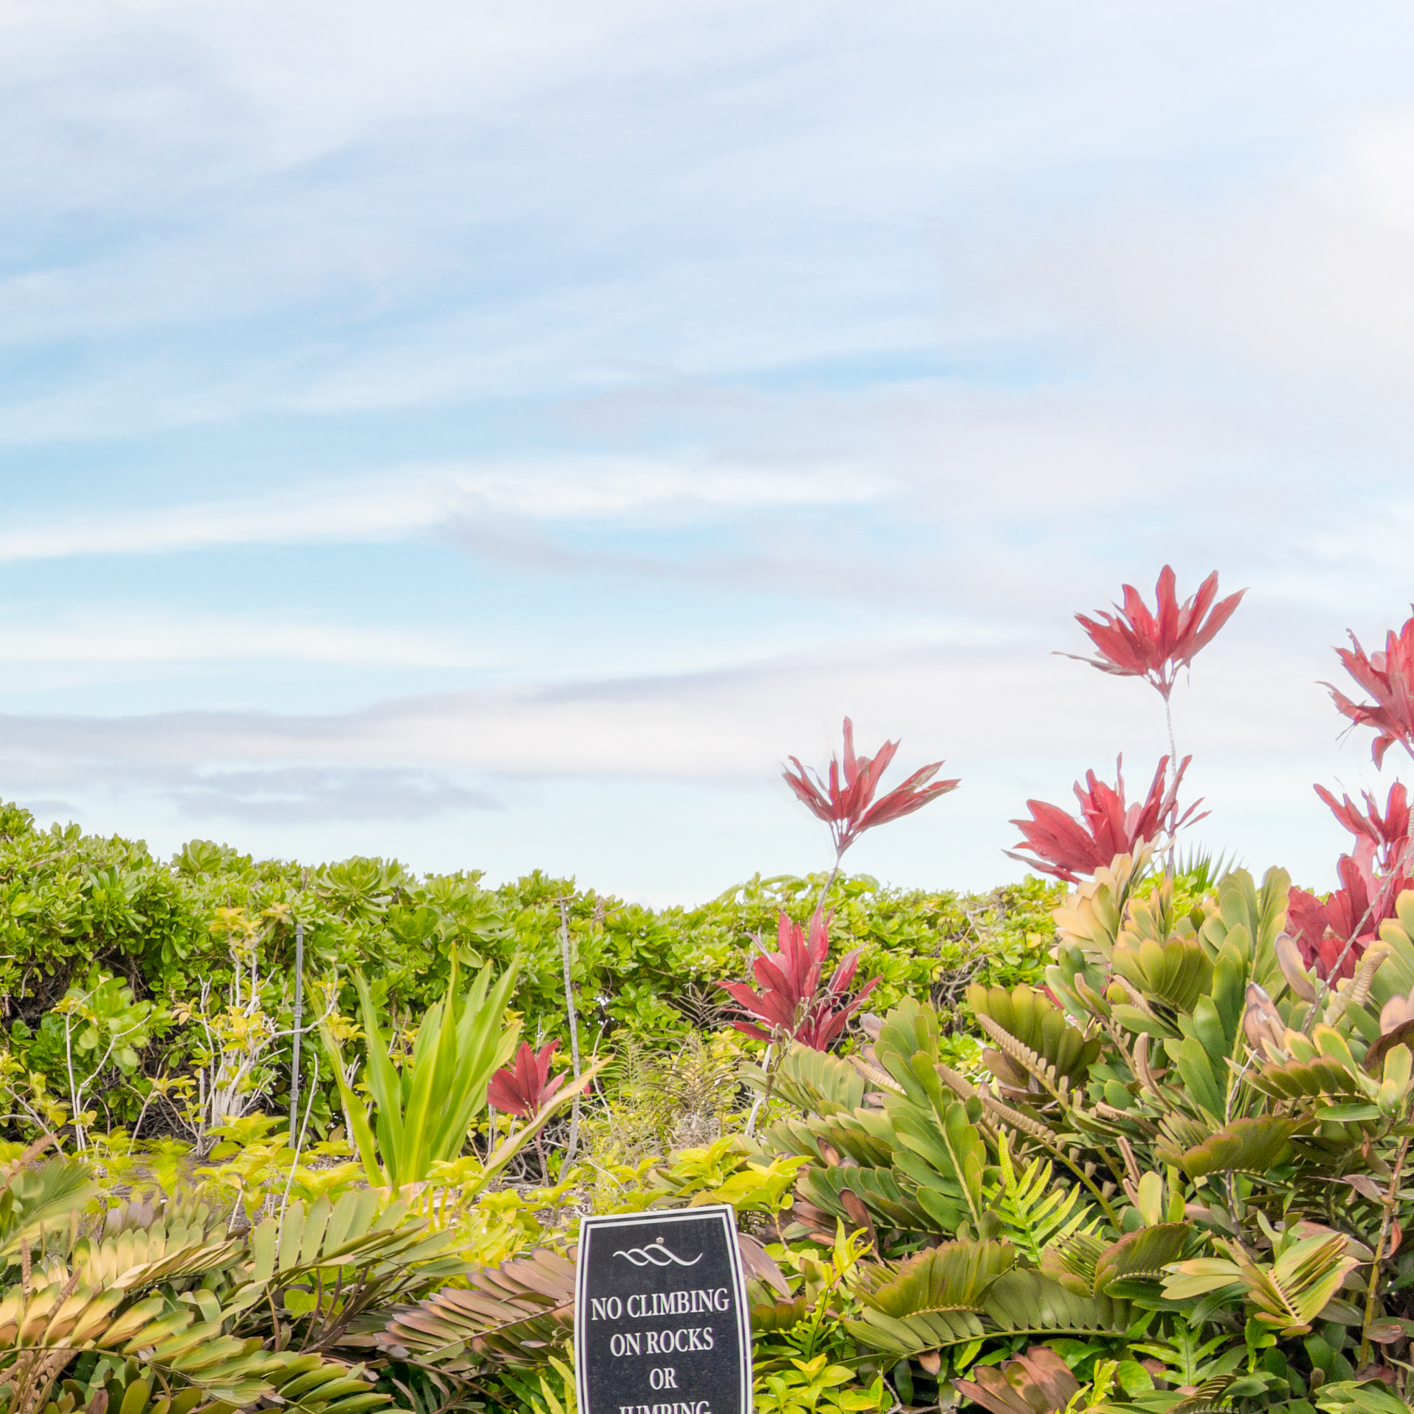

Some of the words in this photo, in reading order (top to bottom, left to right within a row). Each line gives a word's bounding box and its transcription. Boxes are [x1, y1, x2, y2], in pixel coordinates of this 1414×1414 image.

[590, 1296, 623, 1321] NO
[626, 1287, 730, 1318] CLIMBING
[610, 1332, 642, 1357] ON
[645, 1326, 714, 1354] ROCKS
[649, 1367, 679, 1390] OR
